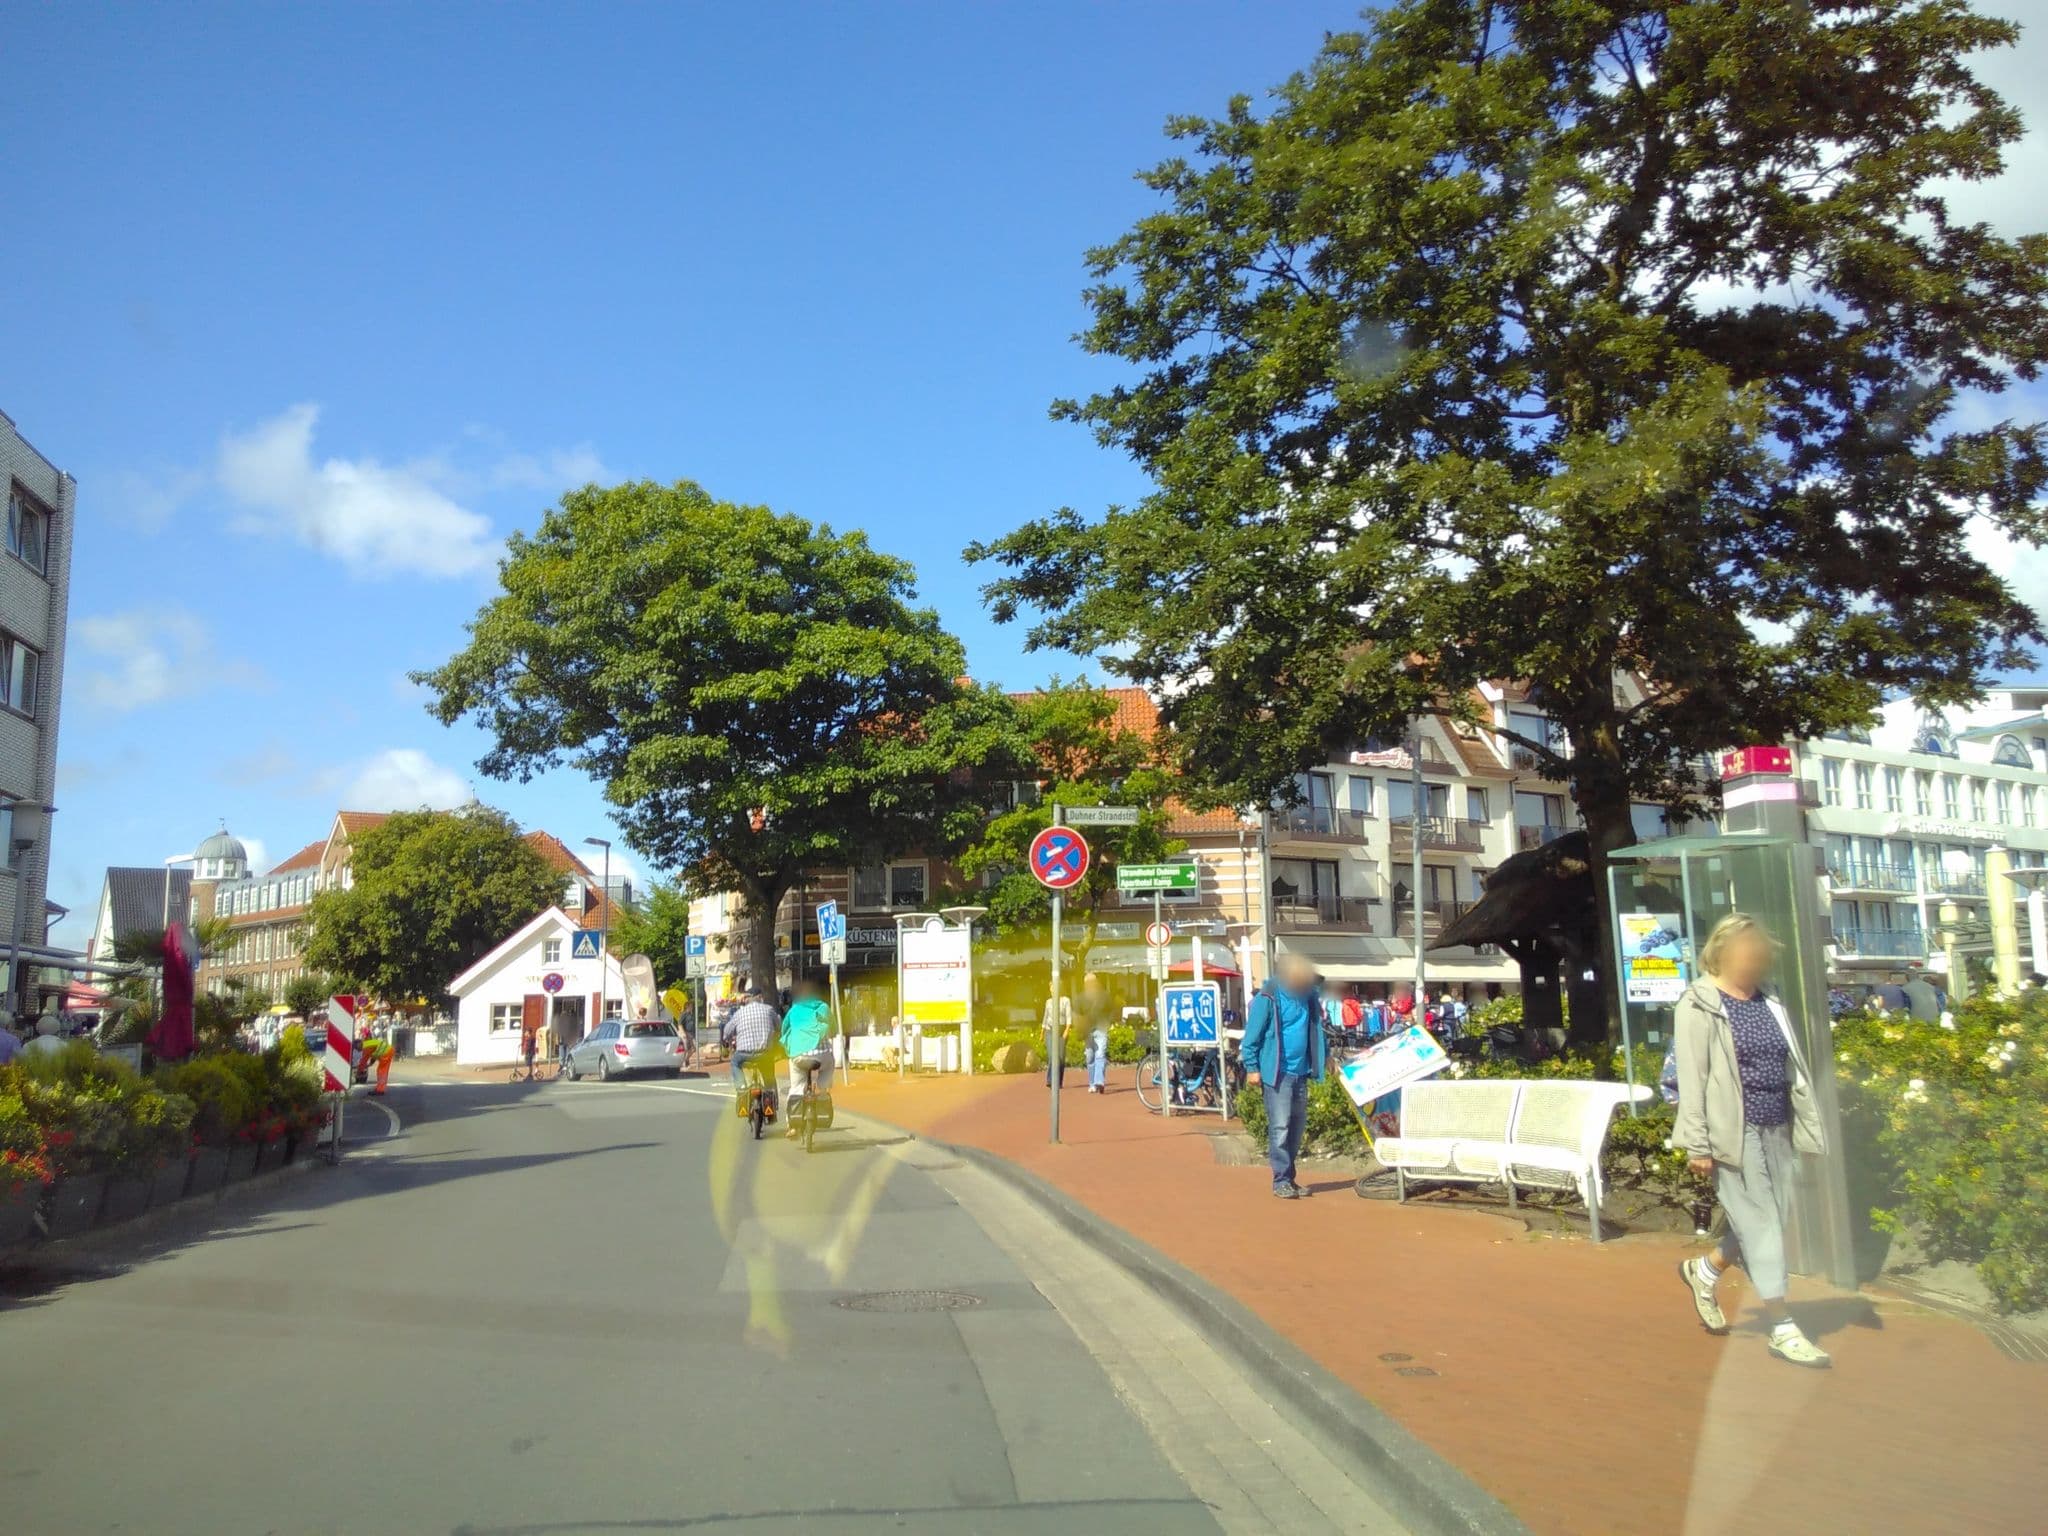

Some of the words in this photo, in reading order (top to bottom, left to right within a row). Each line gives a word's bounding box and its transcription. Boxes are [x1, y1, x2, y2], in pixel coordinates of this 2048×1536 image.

[1120, 867, 1155, 877] Strandhotel
[1120, 878, 1153, 888] Aparthotel
[690, 938, 701, 954] P
